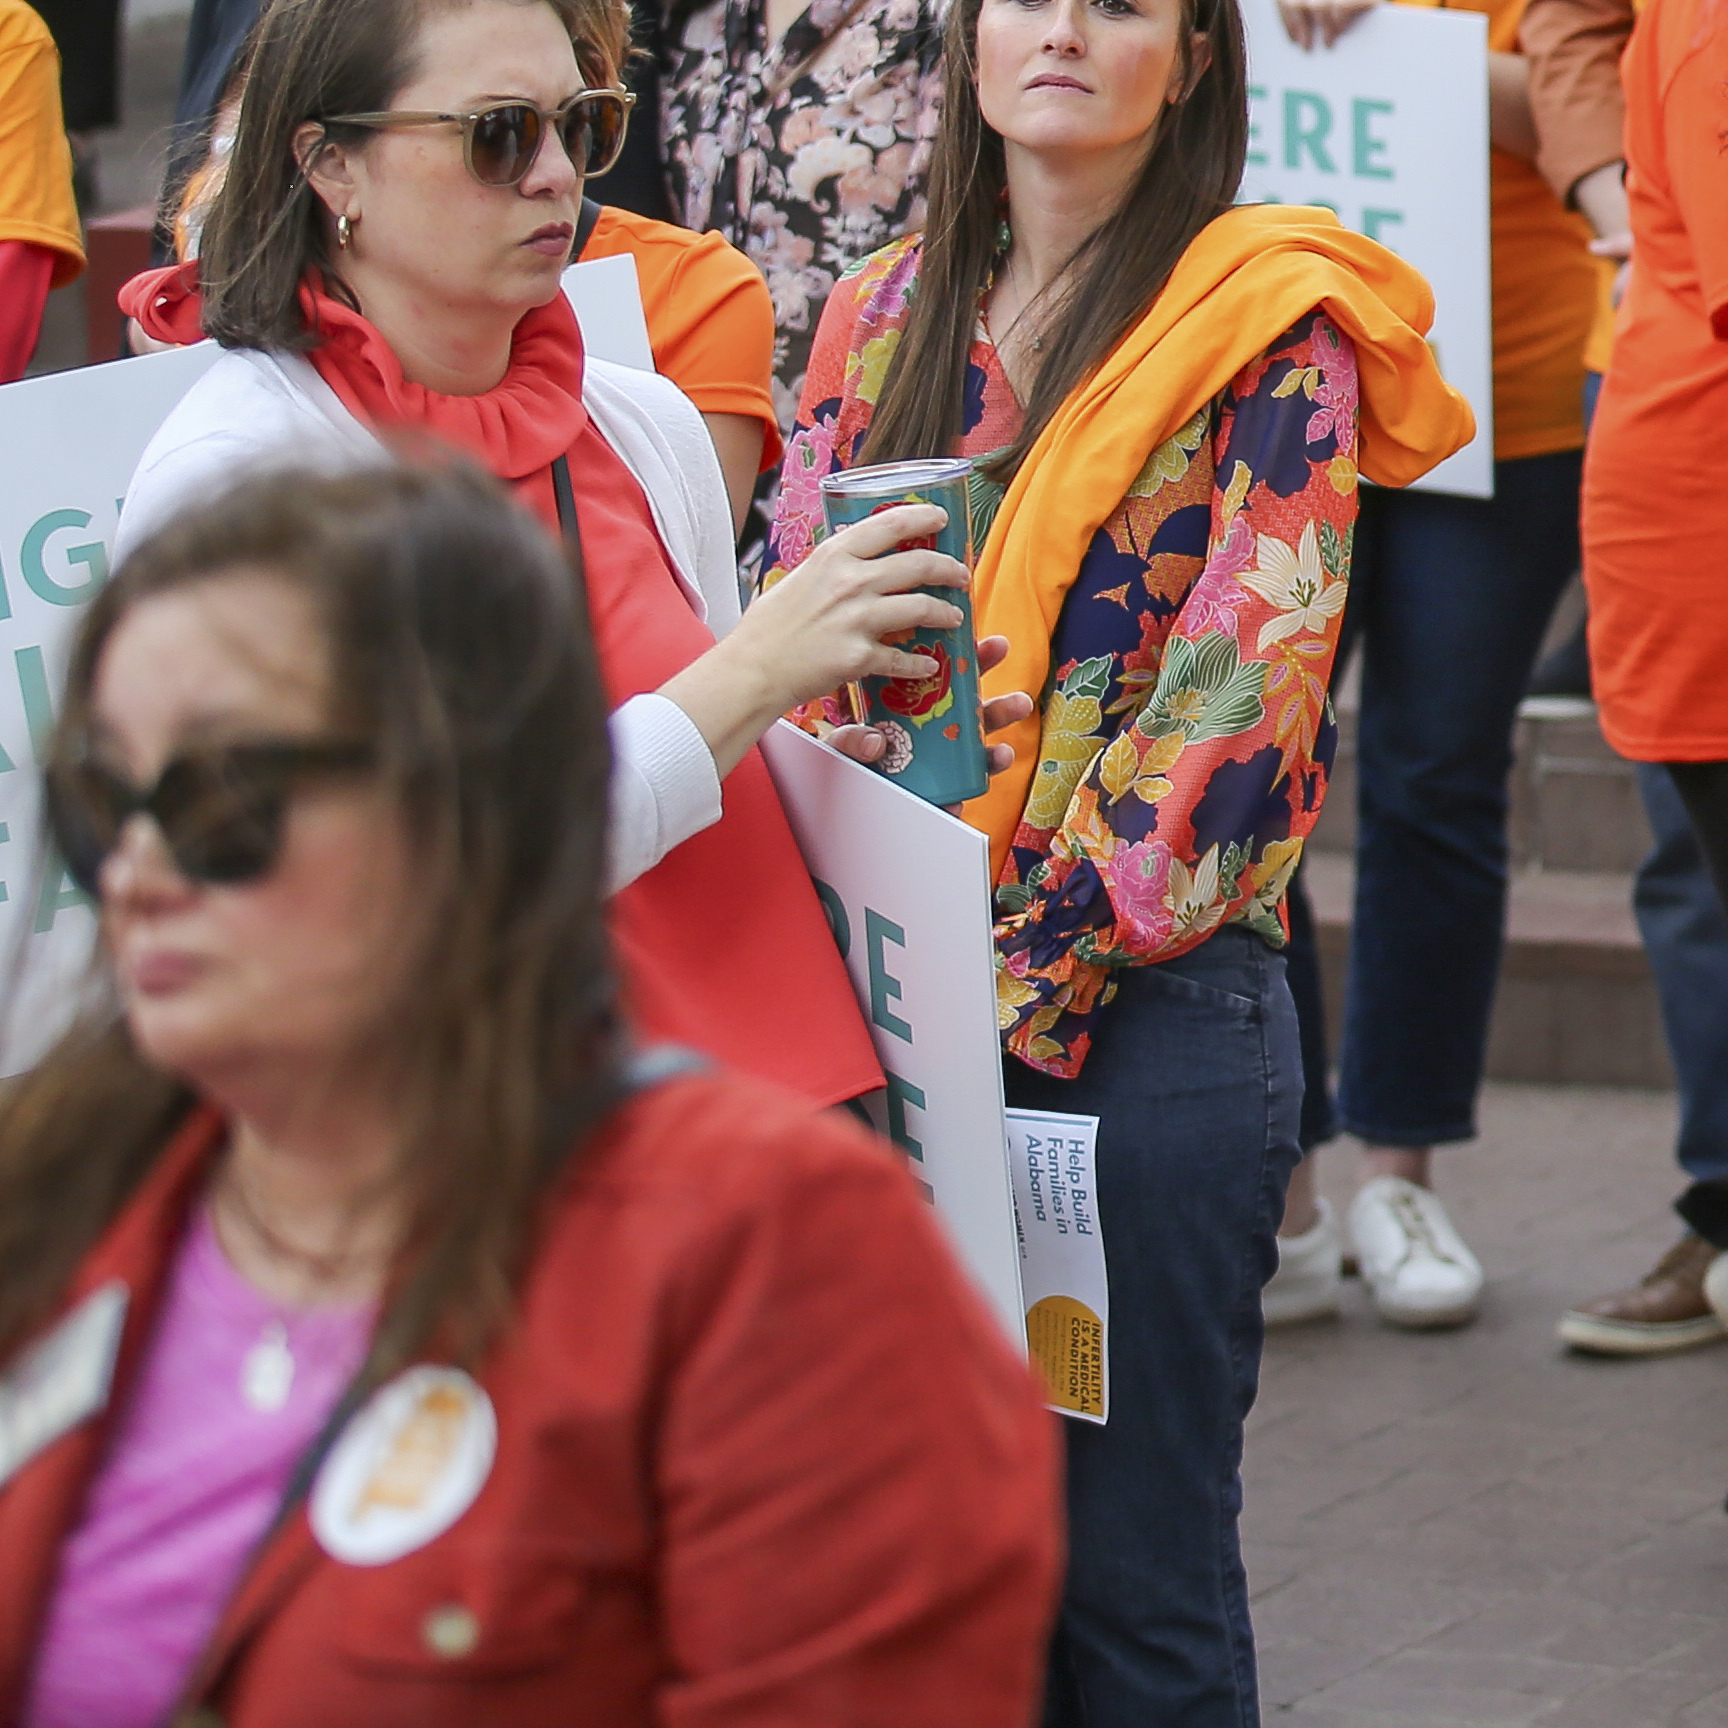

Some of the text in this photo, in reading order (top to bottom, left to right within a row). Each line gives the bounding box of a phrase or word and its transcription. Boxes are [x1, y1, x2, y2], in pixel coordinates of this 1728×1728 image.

[1025, 1134, 1048, 1222] Alabama
[1047, 1136, 1070, 1235] Families in
[1066, 1138, 1093, 1236] Help Build
[1069, 1317, 1080, 1398] CONDITION
[1080, 1318, 1091, 1412] IS A MEDICAL
[1090, 1322, 1101, 1405] INFERTILITY
